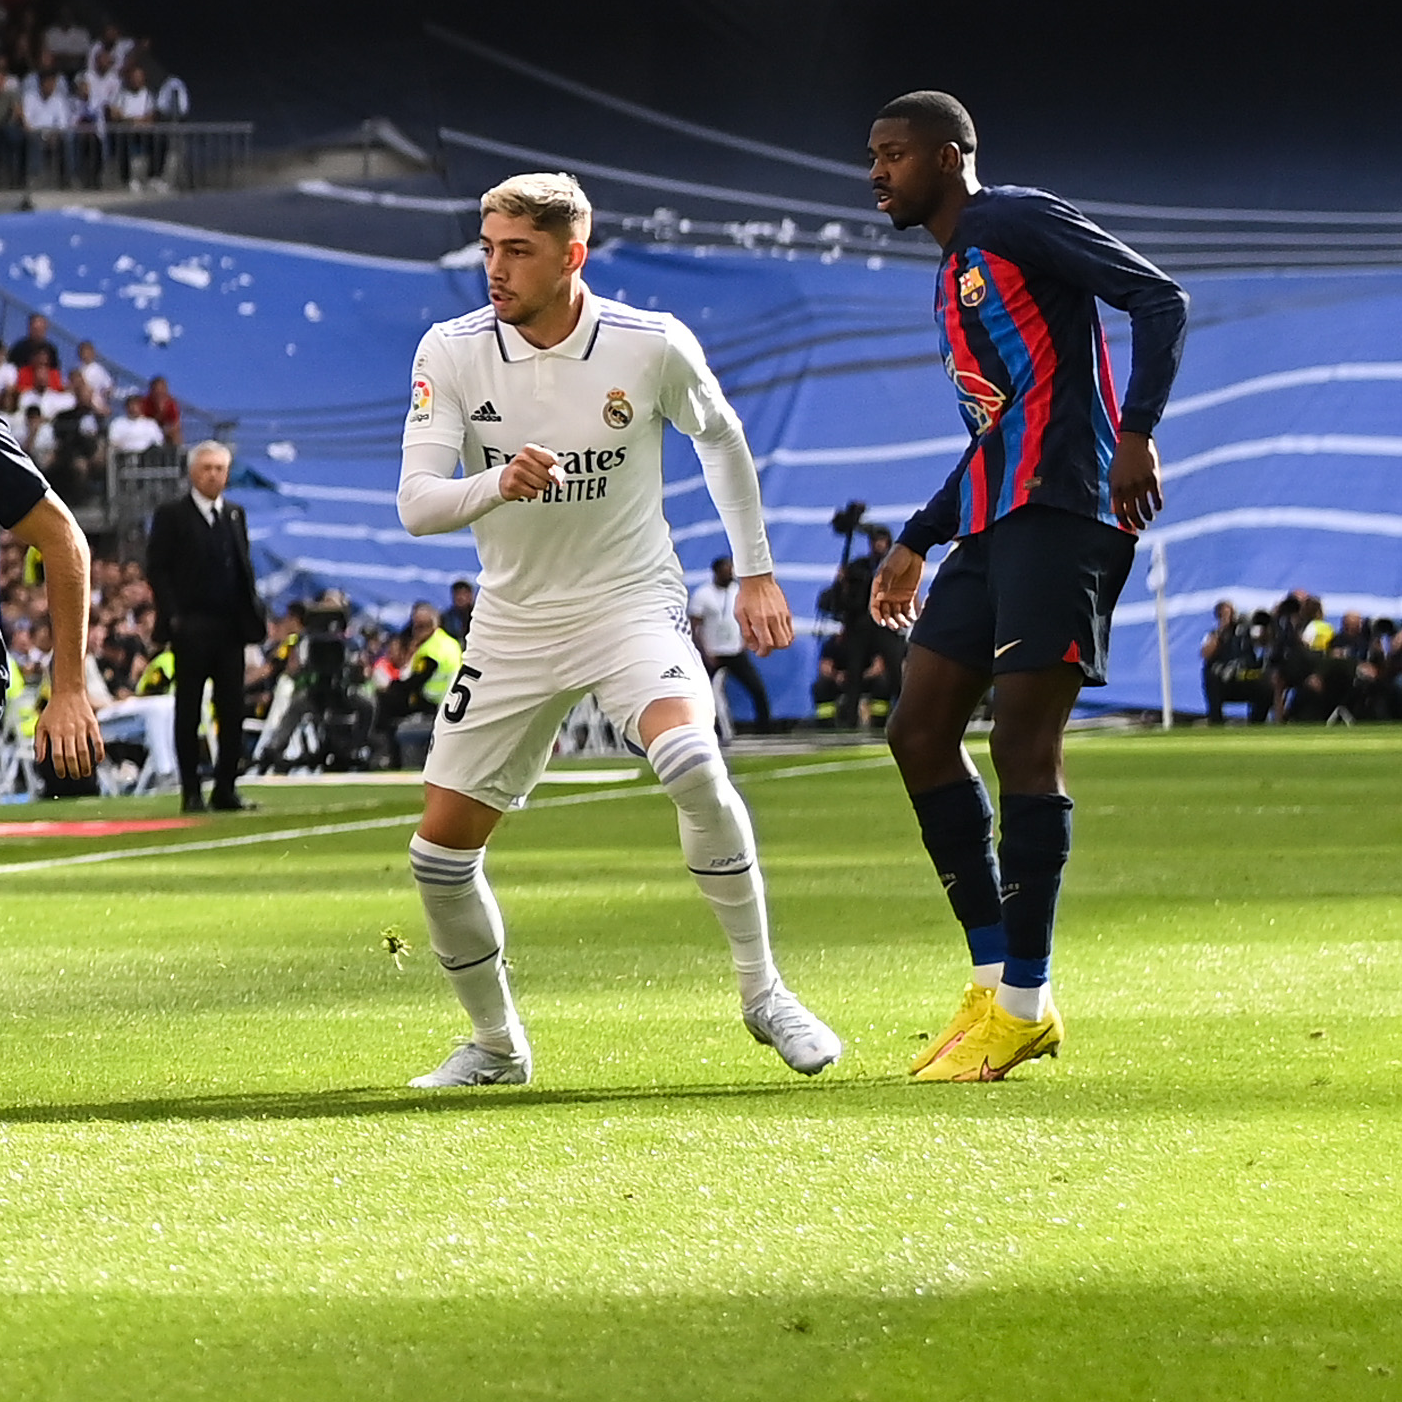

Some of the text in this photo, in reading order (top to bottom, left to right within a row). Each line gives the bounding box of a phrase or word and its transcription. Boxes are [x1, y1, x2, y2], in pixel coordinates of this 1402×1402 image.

[470, 414, 503, 423] adidas
[542, 476, 607, 503] BETTER
[443, 664, 482, 725] 5
